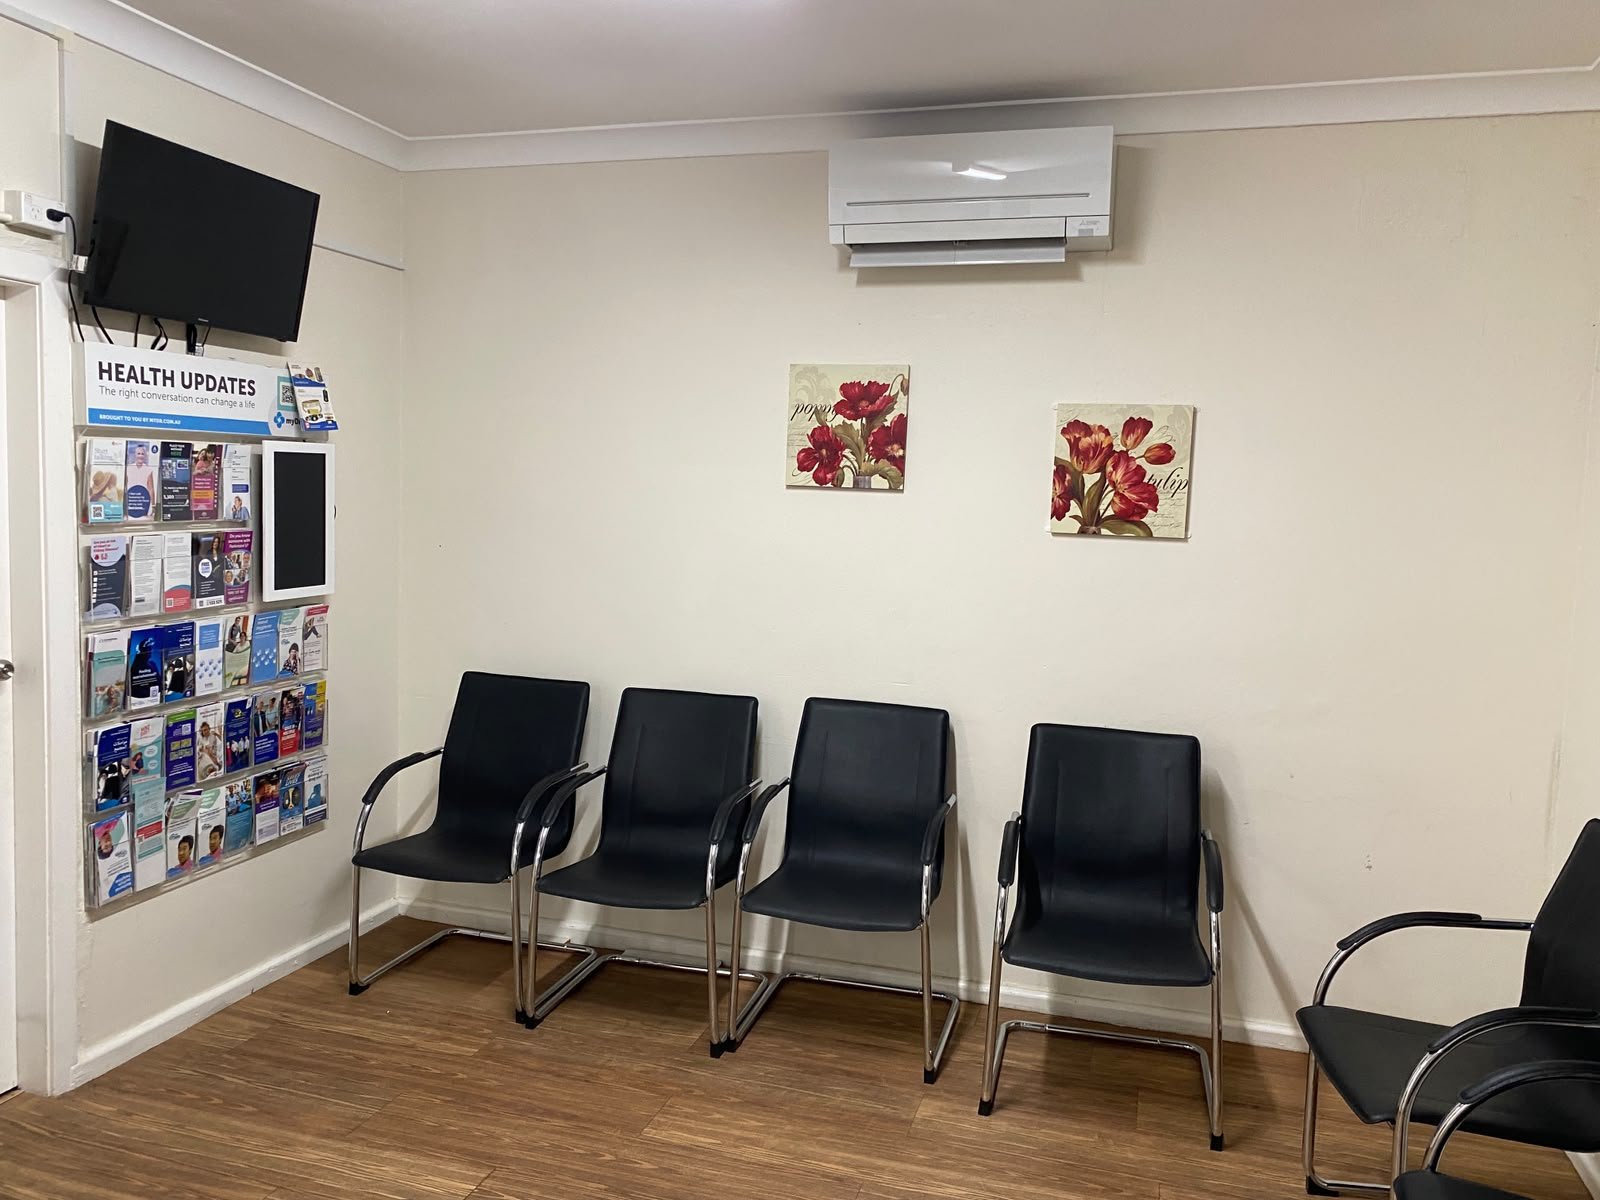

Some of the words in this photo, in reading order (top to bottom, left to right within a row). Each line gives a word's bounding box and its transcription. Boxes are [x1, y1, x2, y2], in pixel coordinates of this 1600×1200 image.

[98, 361, 175, 388] HEALTH
[181, 371, 256, 396] UPDATES
[99, 385, 116, 396] The
[119, 388, 139, 399] right
[141, 391, 193, 403] conversation
[211, 398, 237, 409] change
[245, 400, 255, 409] life
[286, 418, 300, 426] myD
